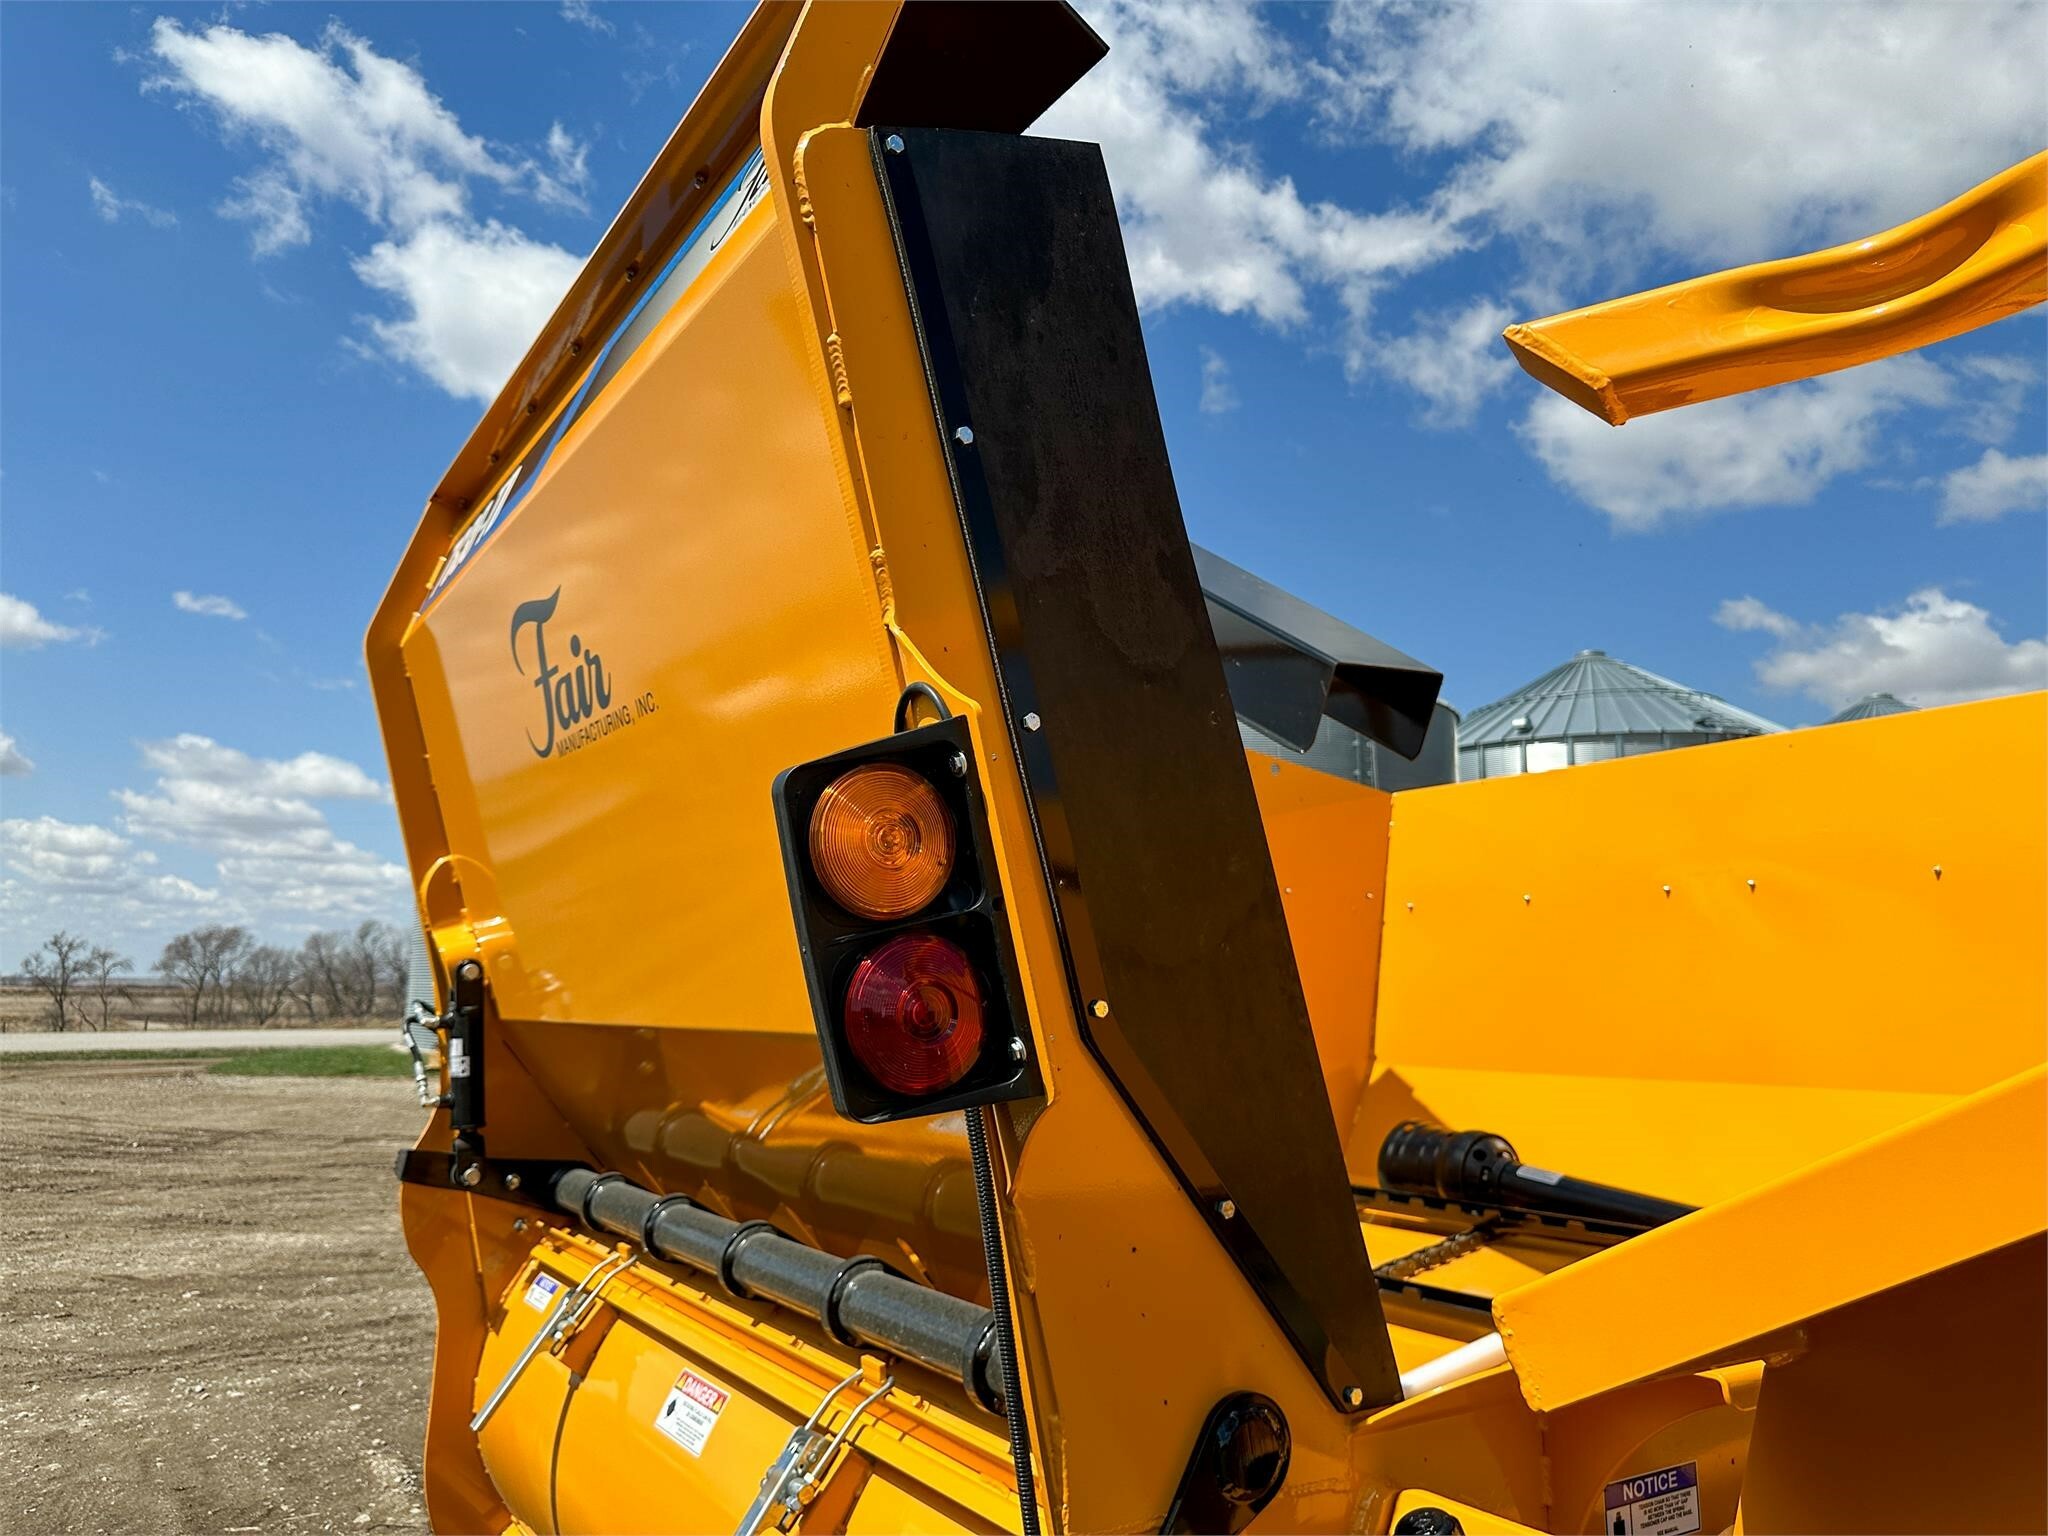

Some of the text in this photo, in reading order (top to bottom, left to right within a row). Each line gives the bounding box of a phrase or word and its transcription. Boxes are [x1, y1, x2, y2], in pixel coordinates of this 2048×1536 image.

[511, 584, 611, 758] Fair
[556, 692, 659, 758] MANUFACTURING, INC.
[682, 1376, 718, 1409] DANGER
[1623, 1470, 1678, 1501] NOTICE
